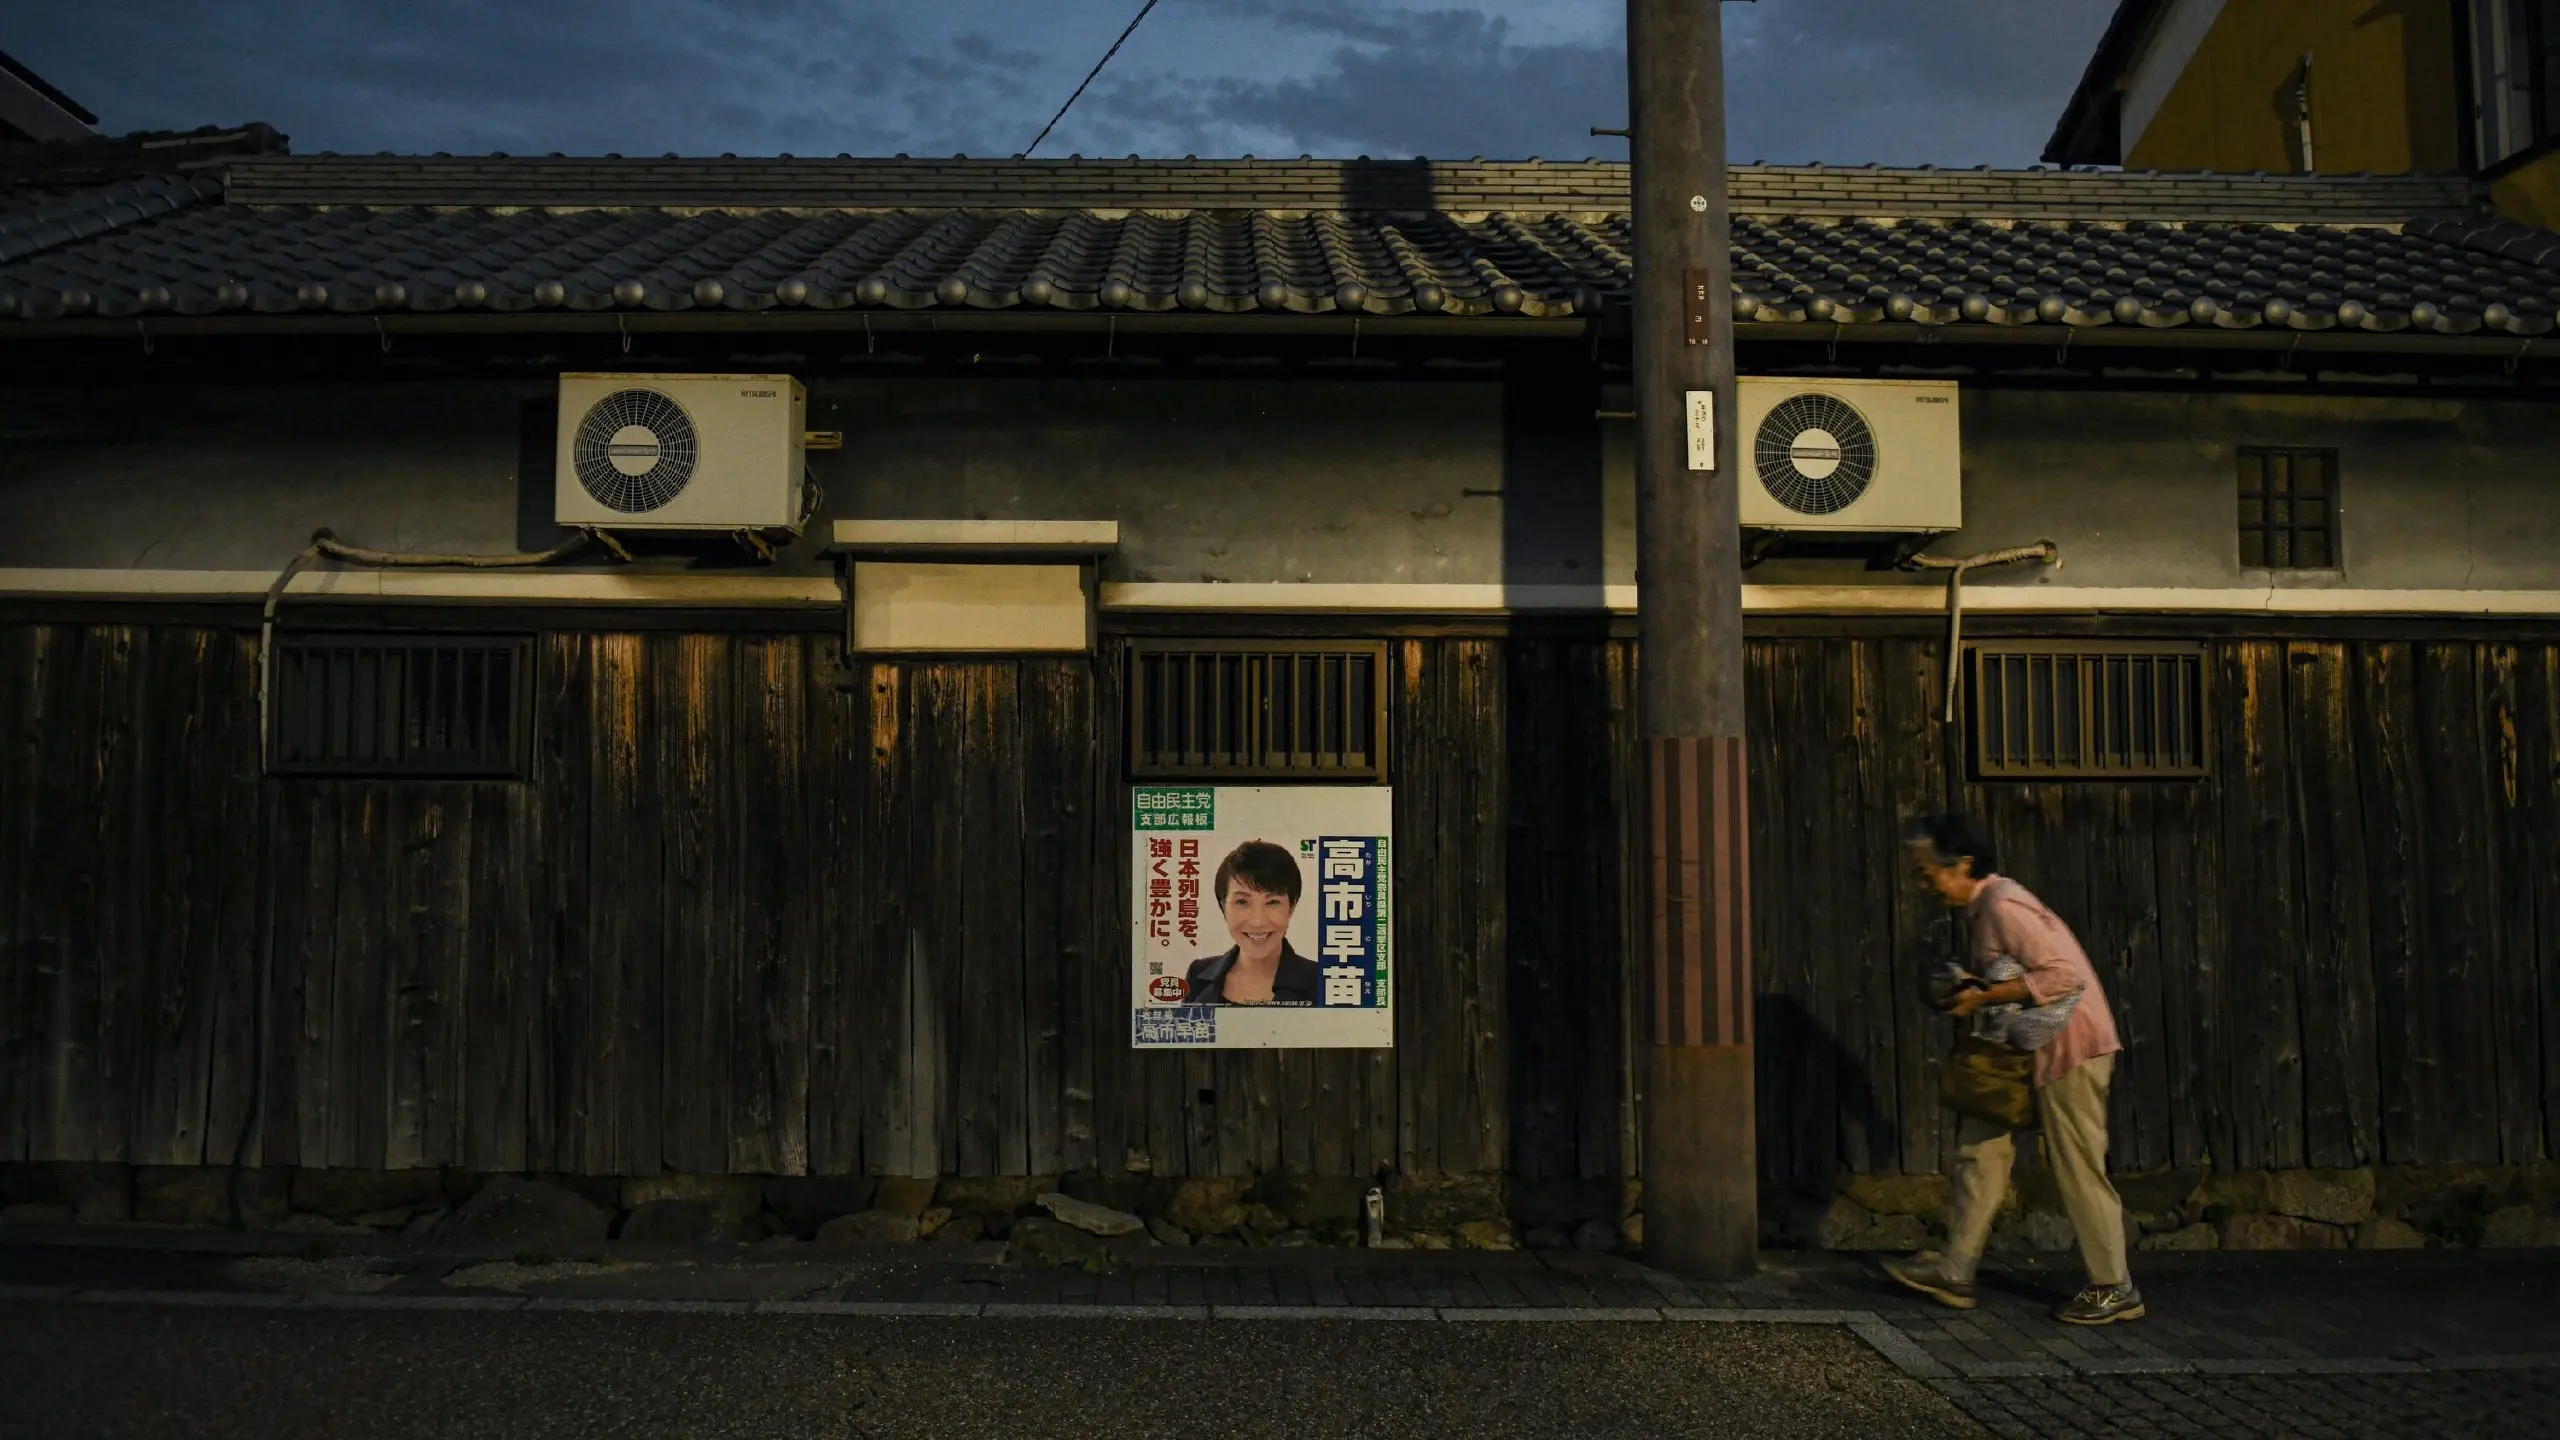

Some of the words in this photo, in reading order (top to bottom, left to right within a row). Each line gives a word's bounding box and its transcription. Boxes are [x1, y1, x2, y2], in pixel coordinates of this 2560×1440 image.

[1137, 793, 1211, 809] 自由民主党
[1140, 812, 1208, 826] 支部広報板
[1300, 839, 1317, 852] ST
[1150, 838, 1173, 948] 強く豊かに。
[1177, 838, 1201, 948] 日本列島を、
[1323, 840, 1365, 1006] 高市早苗
[1160, 977, 1179, 988] 党員
[1141, 1020, 1210, 1042] 高市早苗
